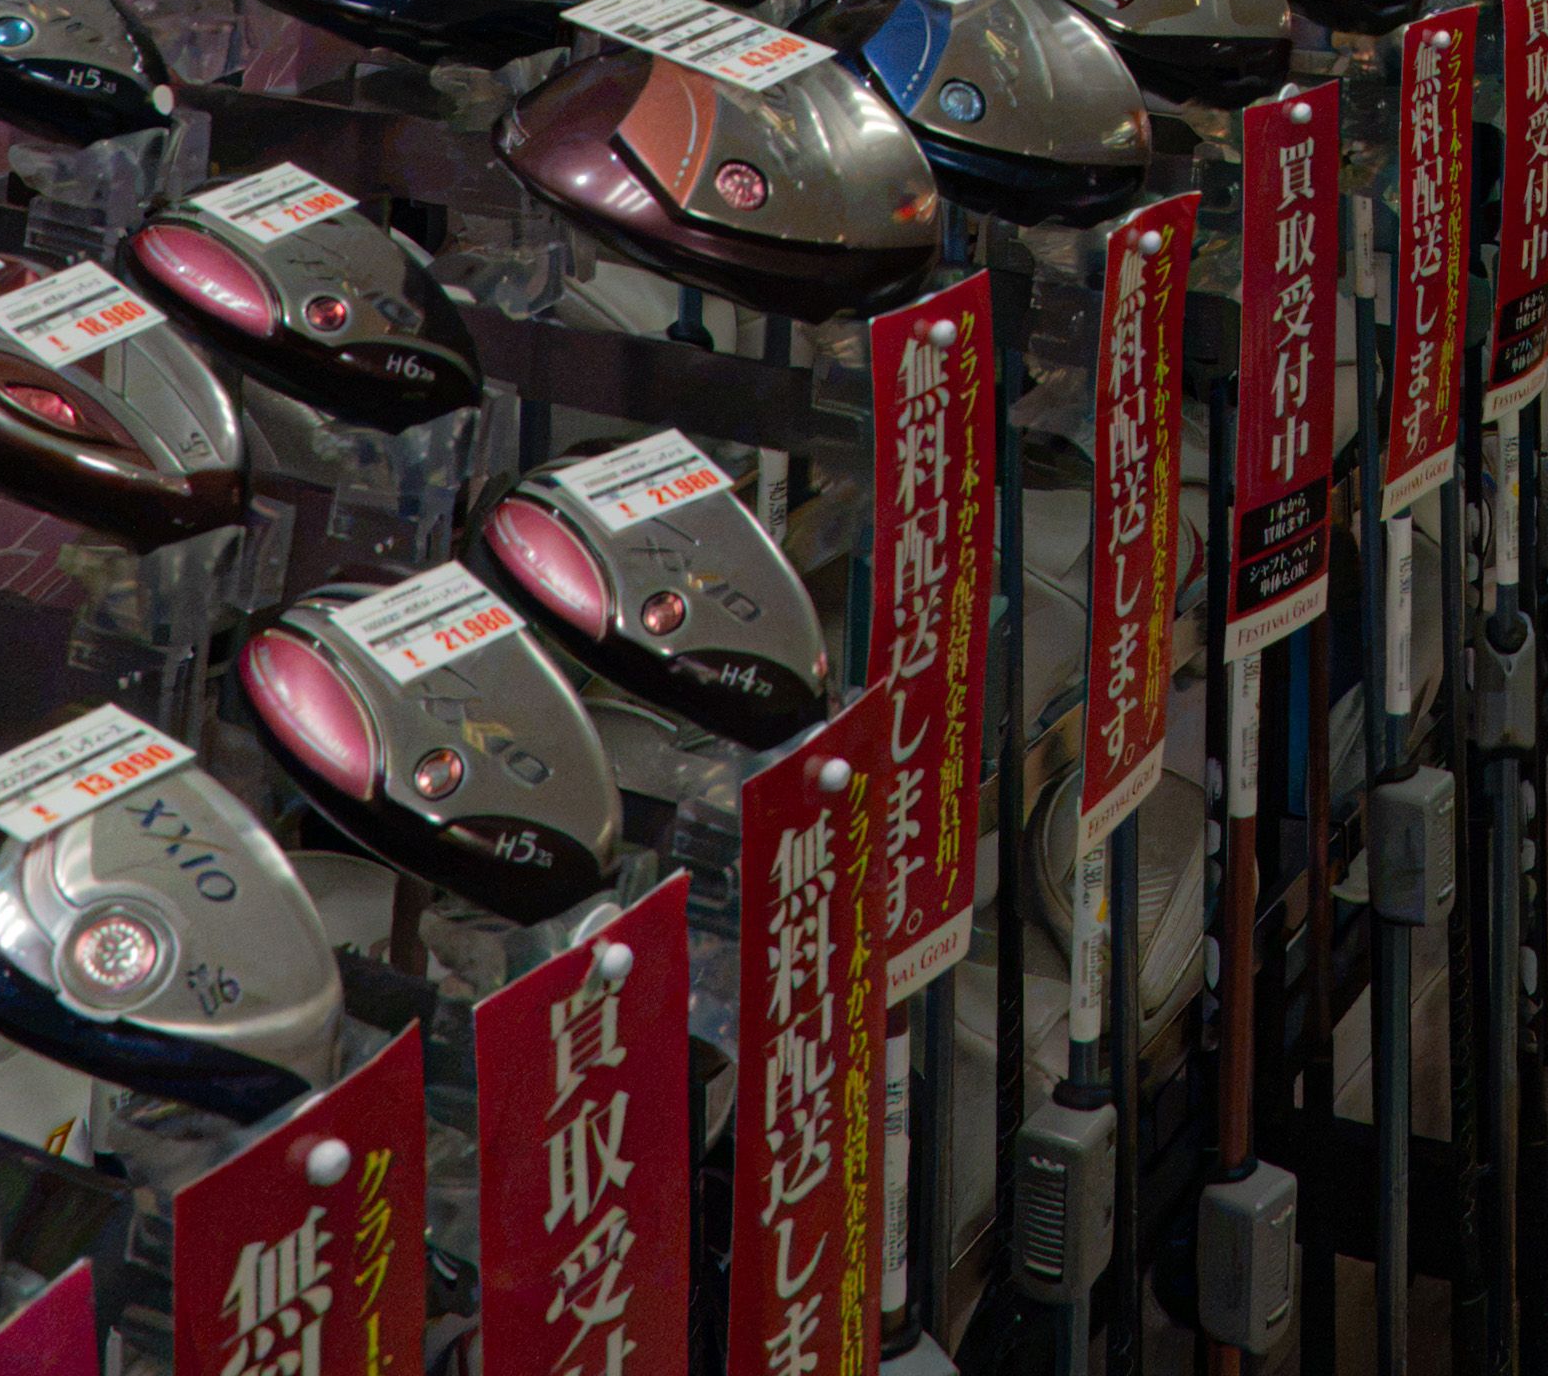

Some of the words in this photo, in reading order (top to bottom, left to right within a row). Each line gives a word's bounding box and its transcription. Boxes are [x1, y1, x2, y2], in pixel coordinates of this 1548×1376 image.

[1404, 40, 1445, 456] 無料配送します。
[76, 300, 149, 338] 18,980
[1268, 138, 1319, 485] 買取受付中
[647, 468, 721, 506] 21,980
[1099, 249, 1146, 770] 無料配送します。
[434, 605, 514, 651] 21,980
[72, 743, 175, 797] 13,990
[132, 797, 239, 907] XXIO
